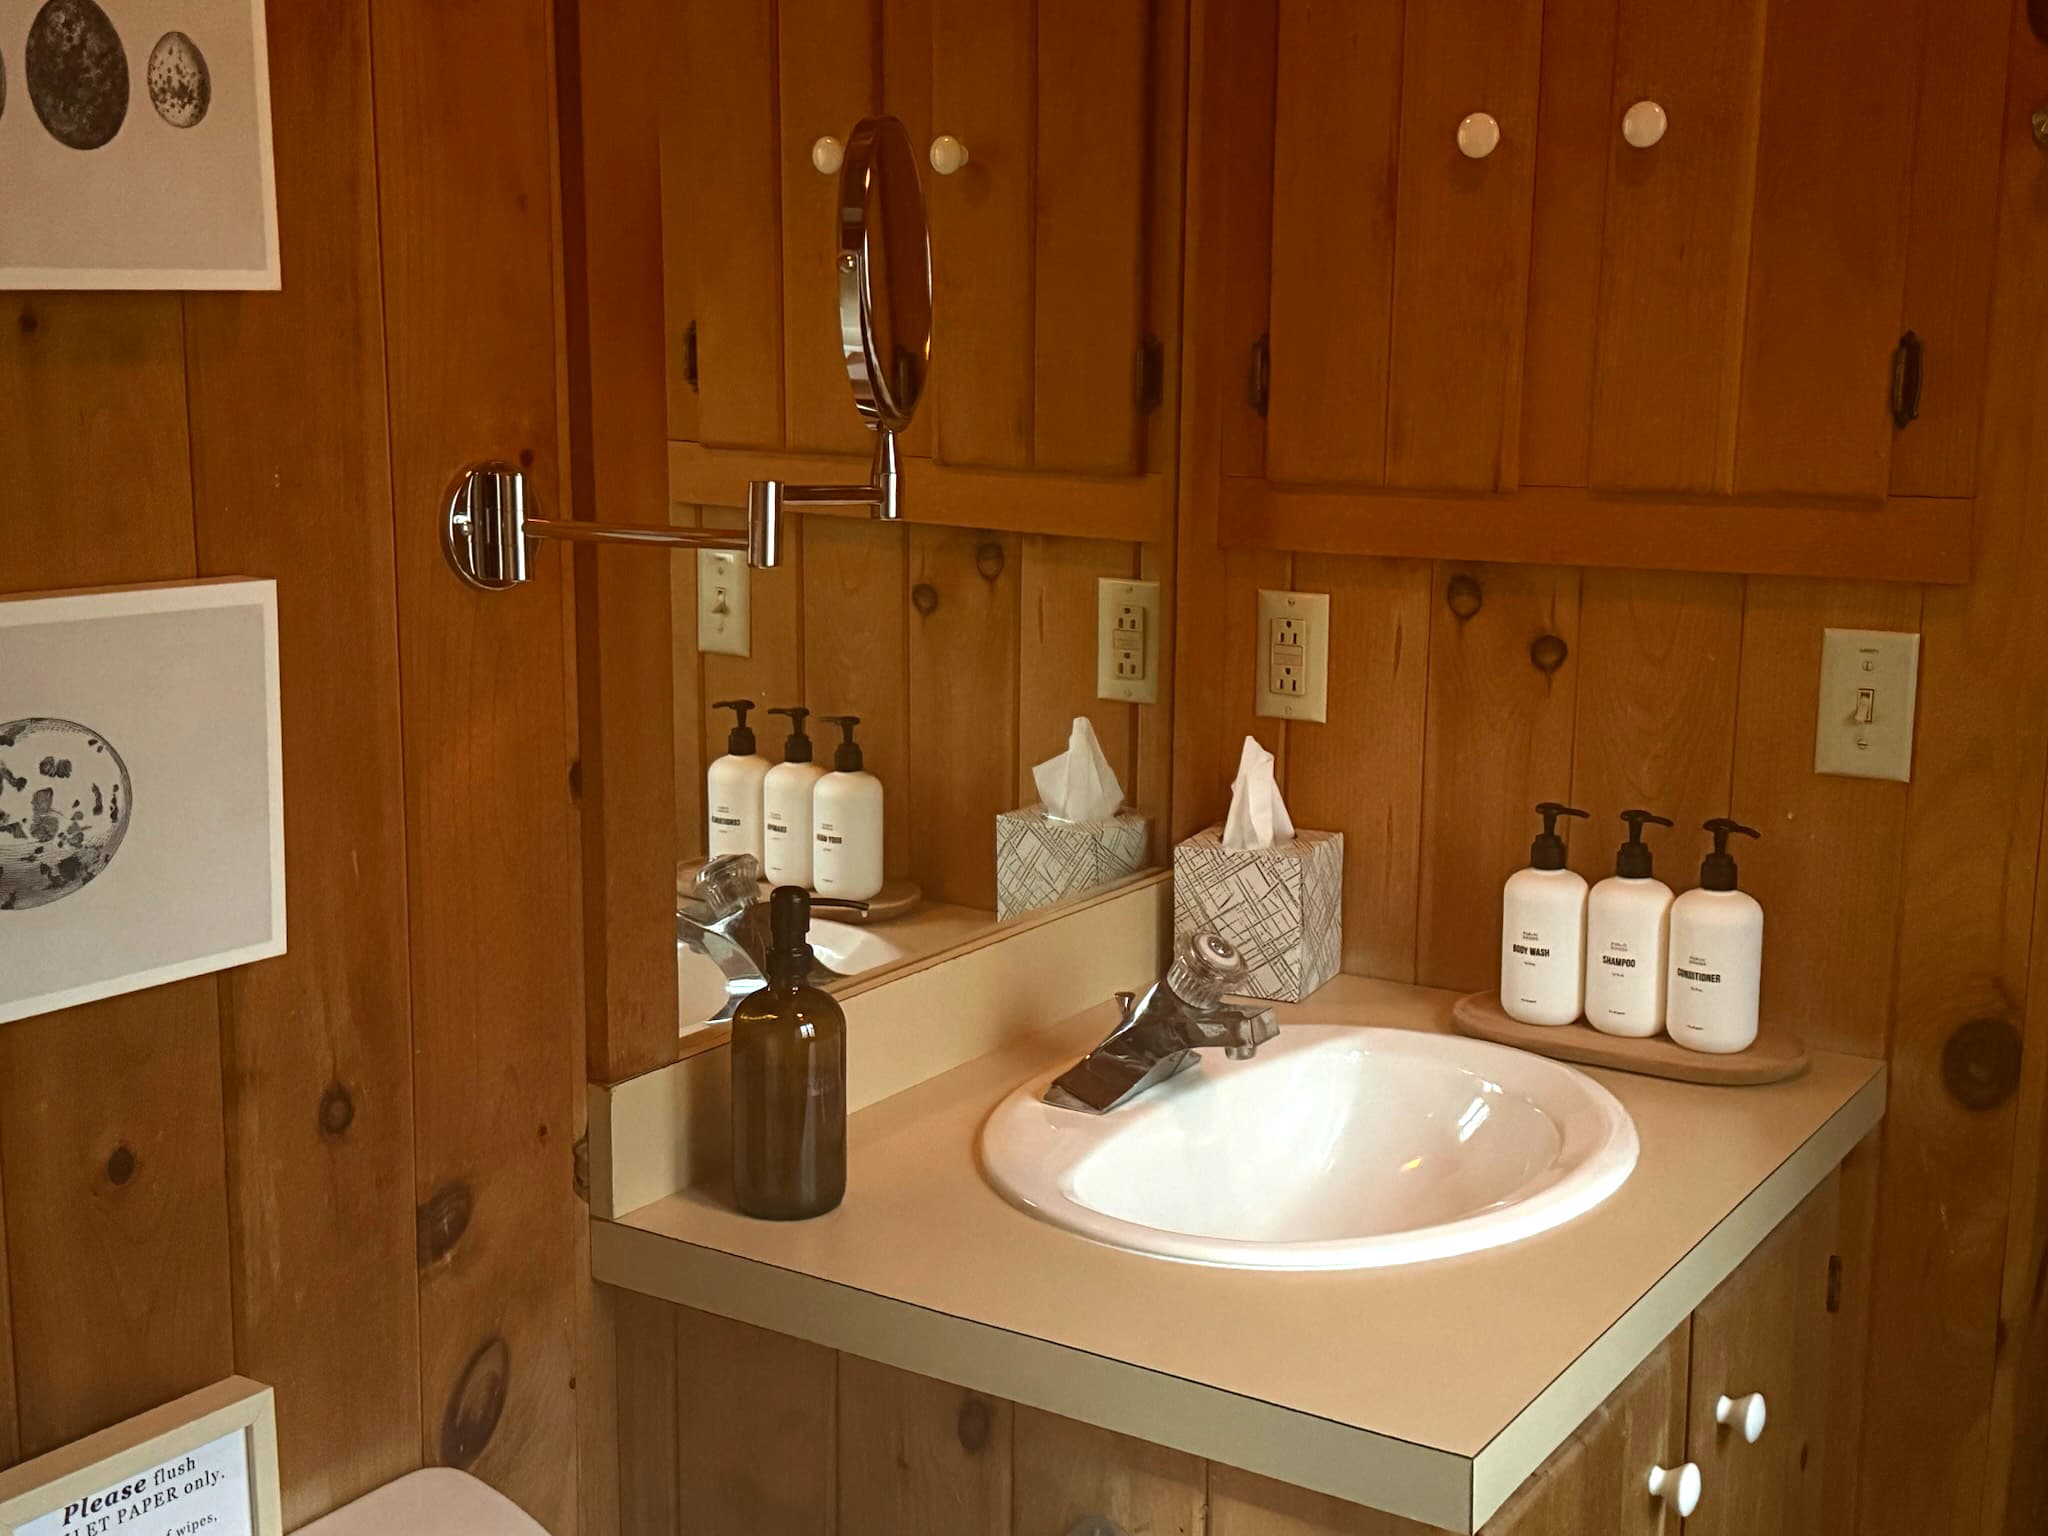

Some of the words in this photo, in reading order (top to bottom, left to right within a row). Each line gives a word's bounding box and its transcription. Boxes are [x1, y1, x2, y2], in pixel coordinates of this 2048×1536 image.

[1512, 943, 1528, 956] BODY
[1529, 947, 1550, 958] WASH
[1602, 955, 1636, 968] SHAMPOO
[1677, 967, 1721, 984] CONDITIONER
[62, 1477, 147, 1527] Please
[153, 1456, 196, 1487] flush
[117, 1488, 179, 1525] PAPER
[184, 1470, 225, 1495] only.
[176, 1514, 218, 1536] wipes,
